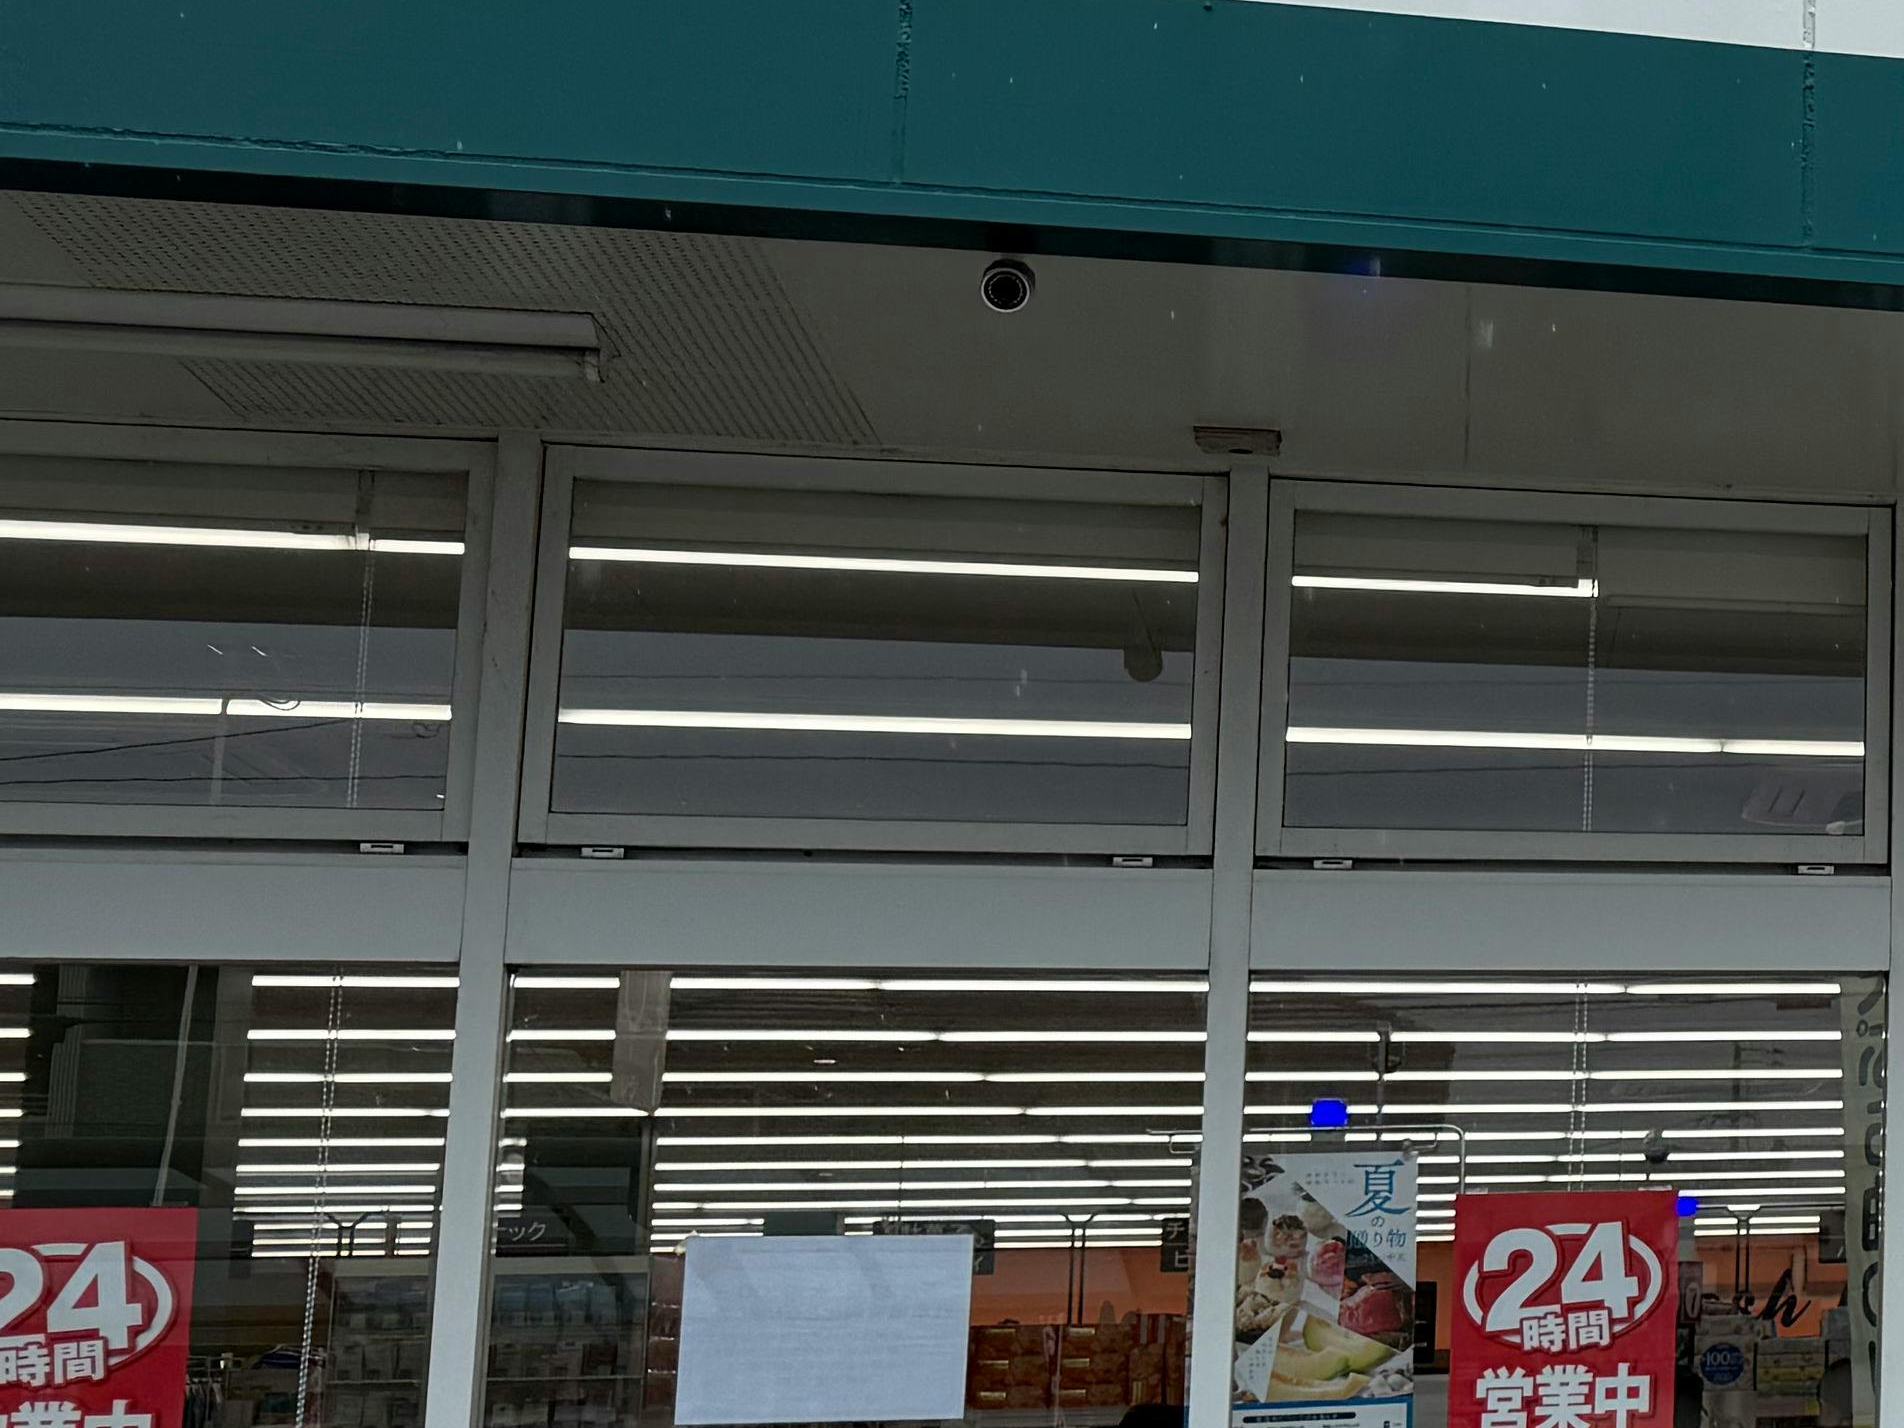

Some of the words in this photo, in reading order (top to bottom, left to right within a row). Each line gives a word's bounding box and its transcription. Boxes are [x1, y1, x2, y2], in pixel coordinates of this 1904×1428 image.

[1345, 1159, 1411, 1217] 夏
[1371, 1215, 1385, 1228] の
[0, 1240, 143, 1350] 24
[1483, 1221, 1641, 1334] 24
[1520, 1313, 1612, 1354] 時間
[0, 1341, 106, 1387] 時間
